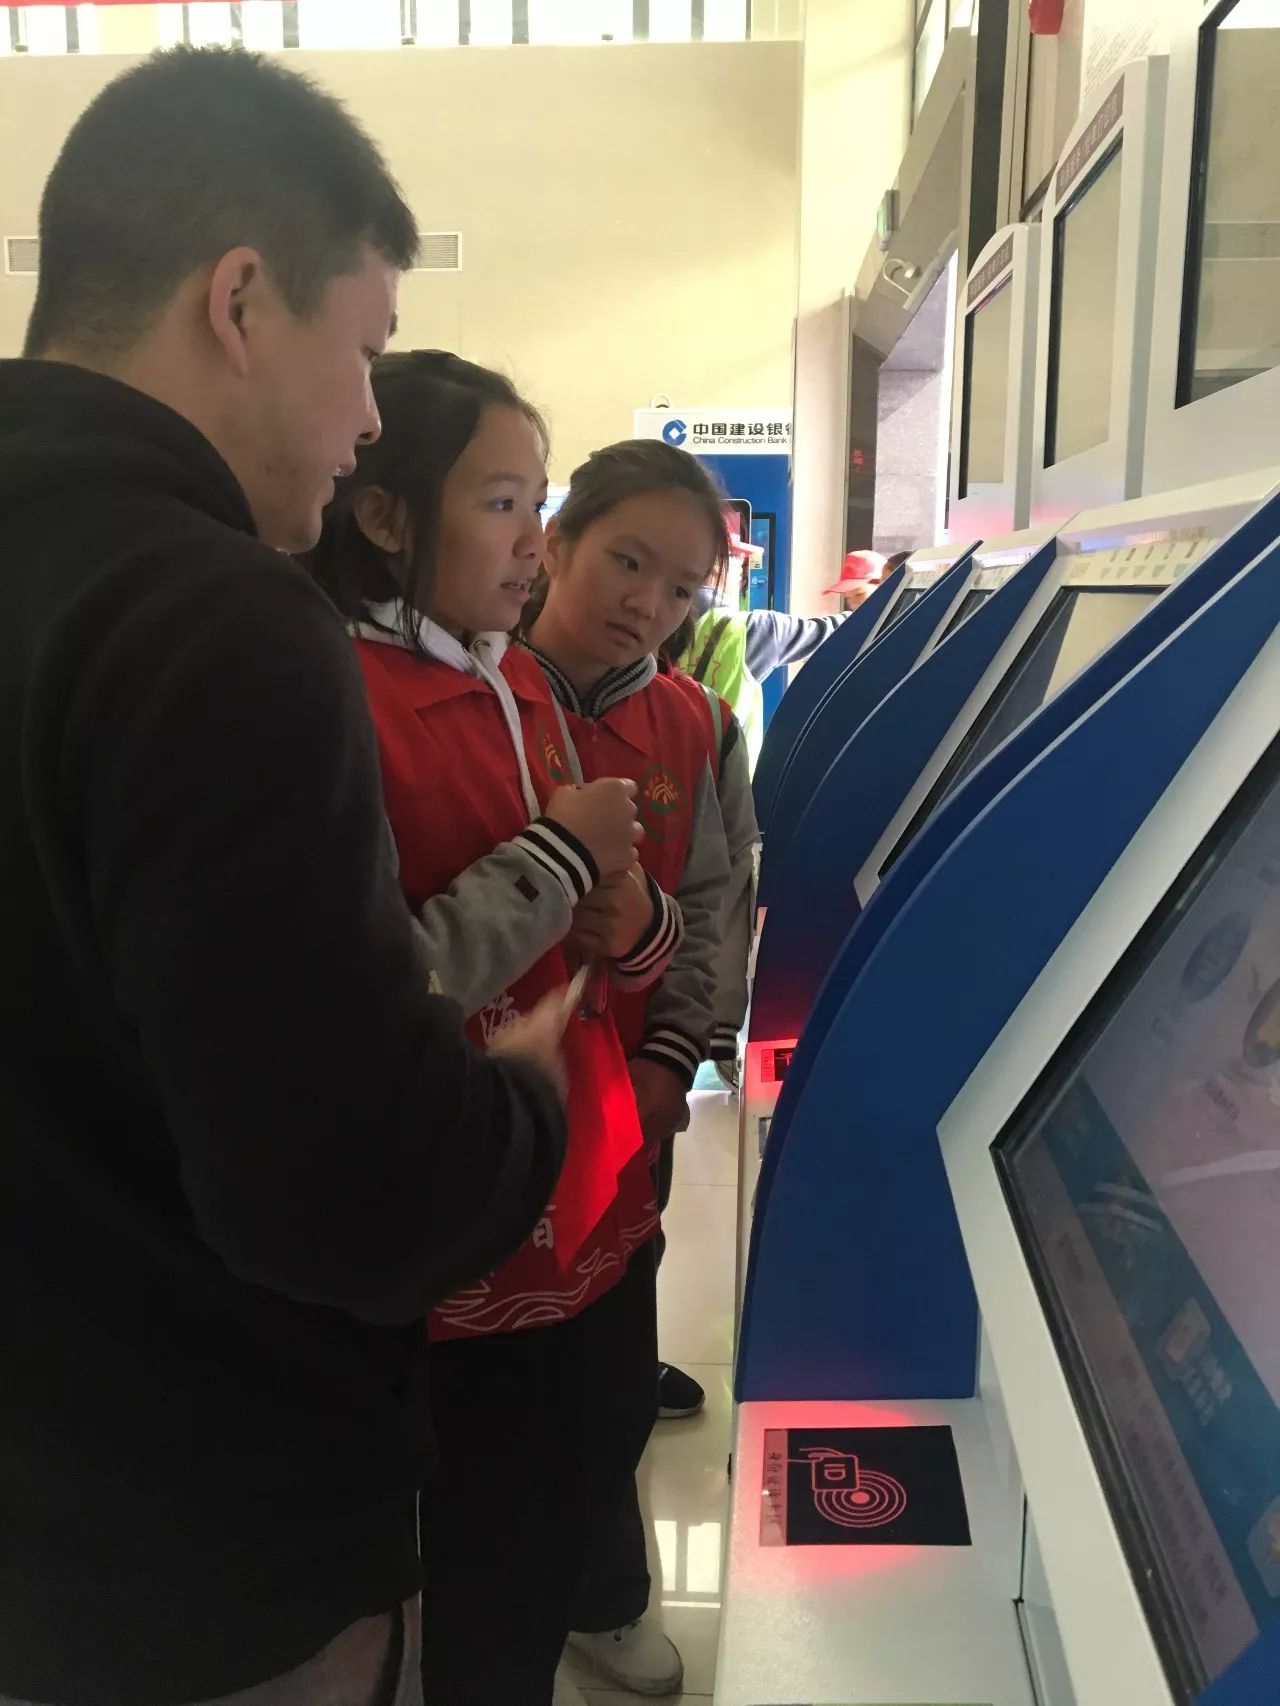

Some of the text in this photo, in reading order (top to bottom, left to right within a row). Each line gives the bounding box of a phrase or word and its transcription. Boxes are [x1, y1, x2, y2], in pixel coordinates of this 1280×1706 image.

[693, 436, 787, 444] China Construction Bank
